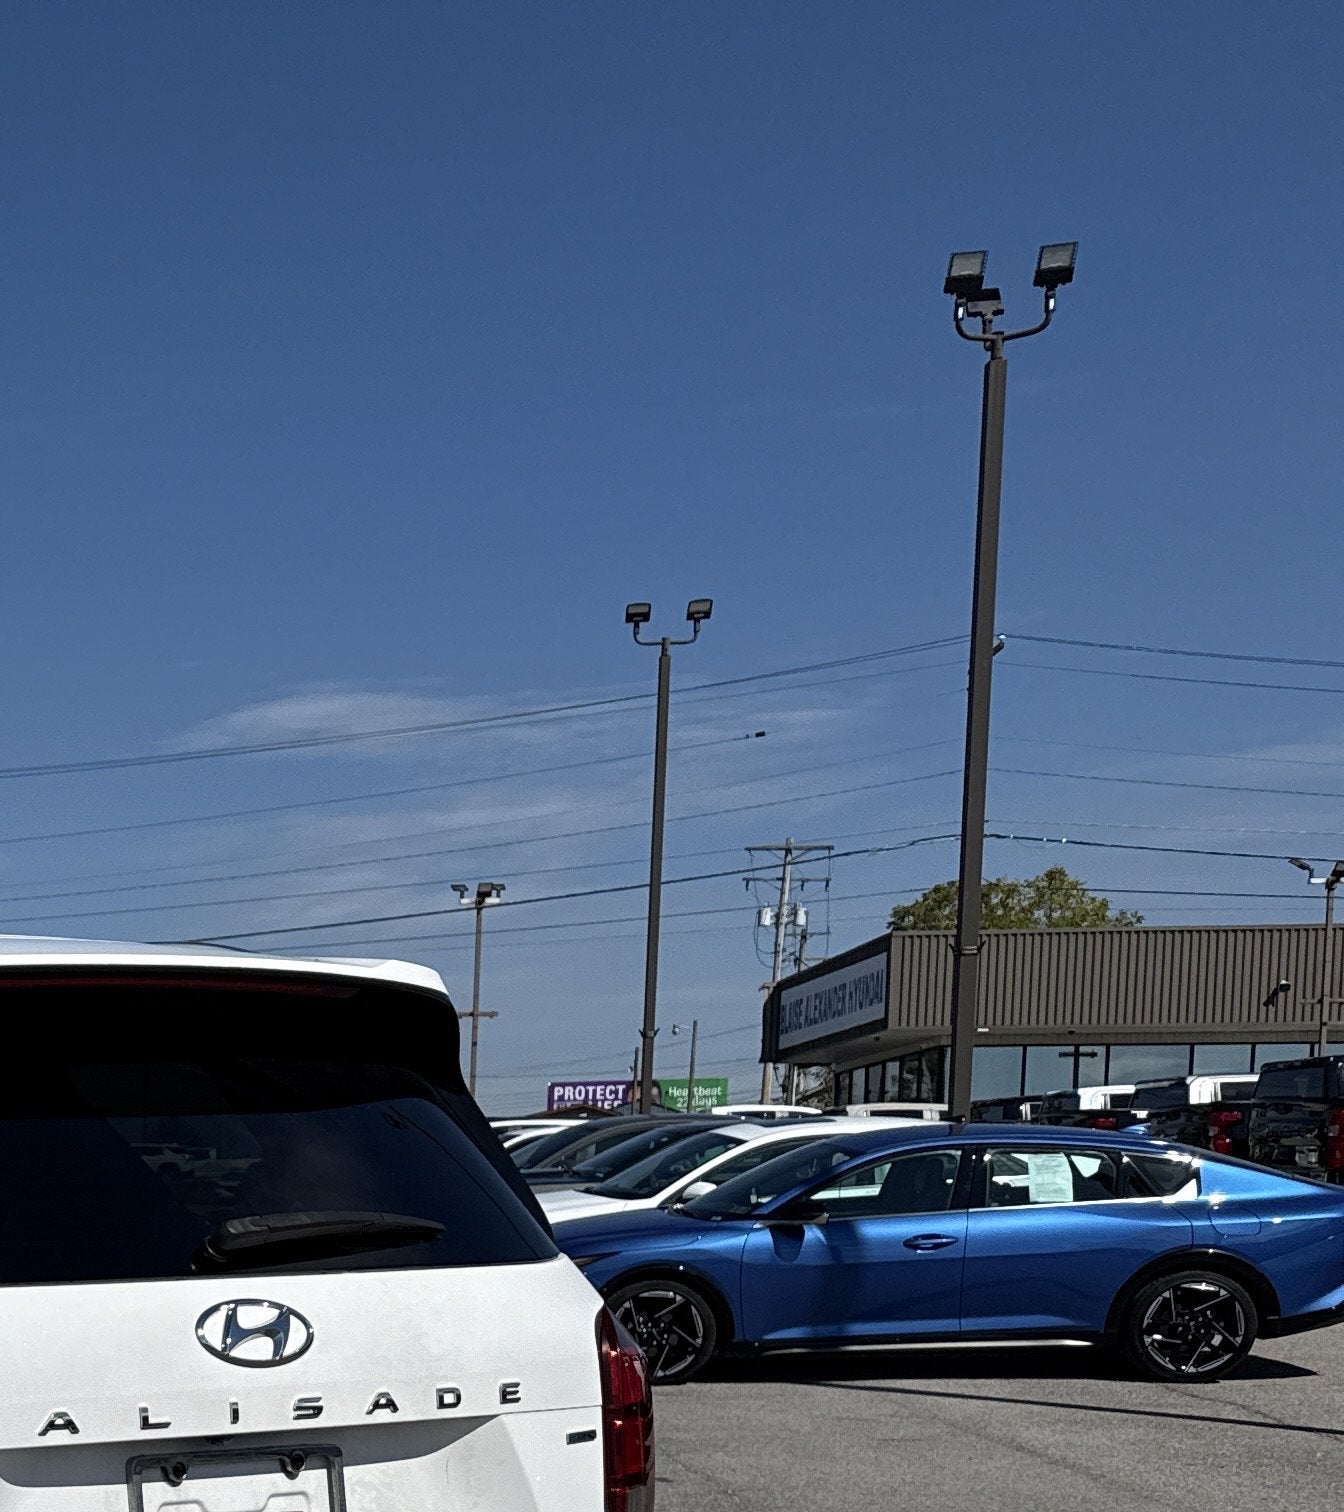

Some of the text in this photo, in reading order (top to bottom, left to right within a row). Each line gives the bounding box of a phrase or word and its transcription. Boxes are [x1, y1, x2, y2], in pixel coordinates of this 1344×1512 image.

[780, 969, 884, 1035] BLAISE ALEXANDER HYUNDAI
[553, 1084, 626, 1101] PROTECT
[668, 1086, 722, 1097] Heatbeat
[692, 1095, 718, 1107] days
